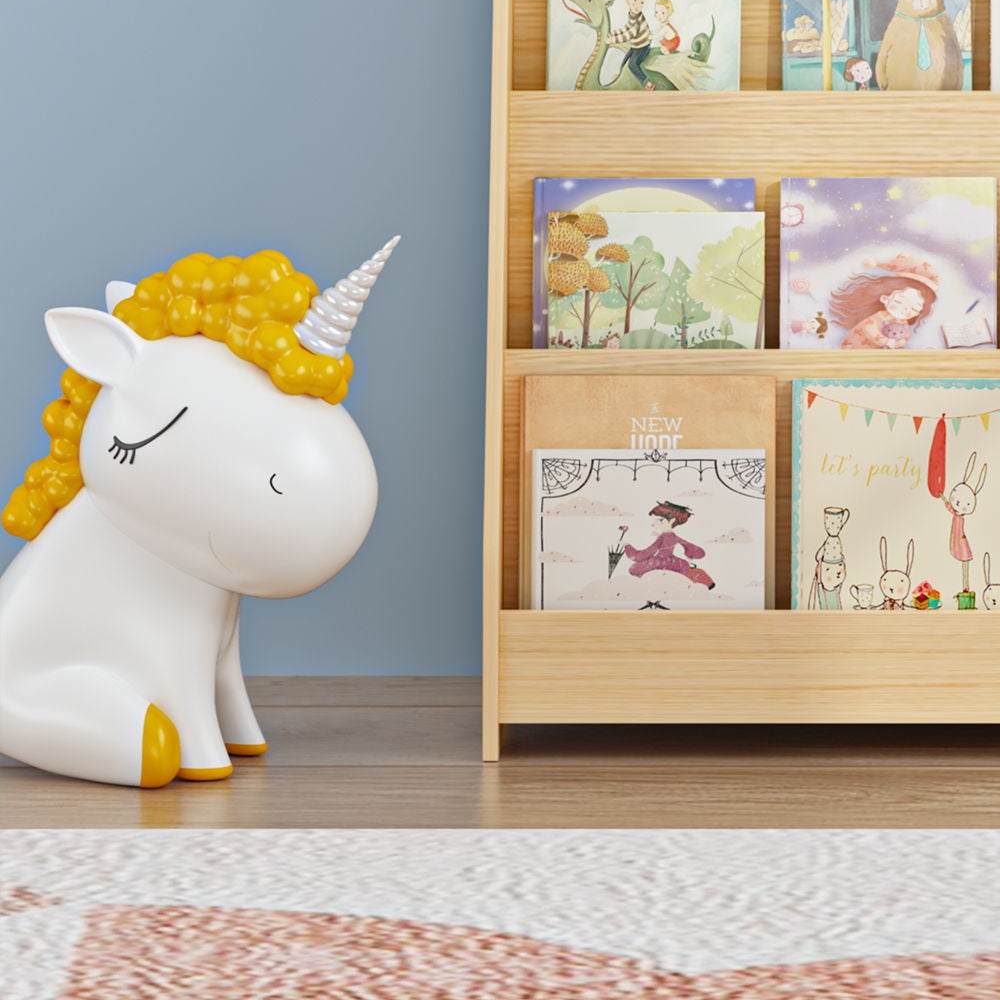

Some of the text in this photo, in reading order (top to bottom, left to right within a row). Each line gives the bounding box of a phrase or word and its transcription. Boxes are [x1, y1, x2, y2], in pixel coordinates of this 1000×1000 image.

[630, 416, 684, 433] NEW
[820, 452, 922, 491] let's party
